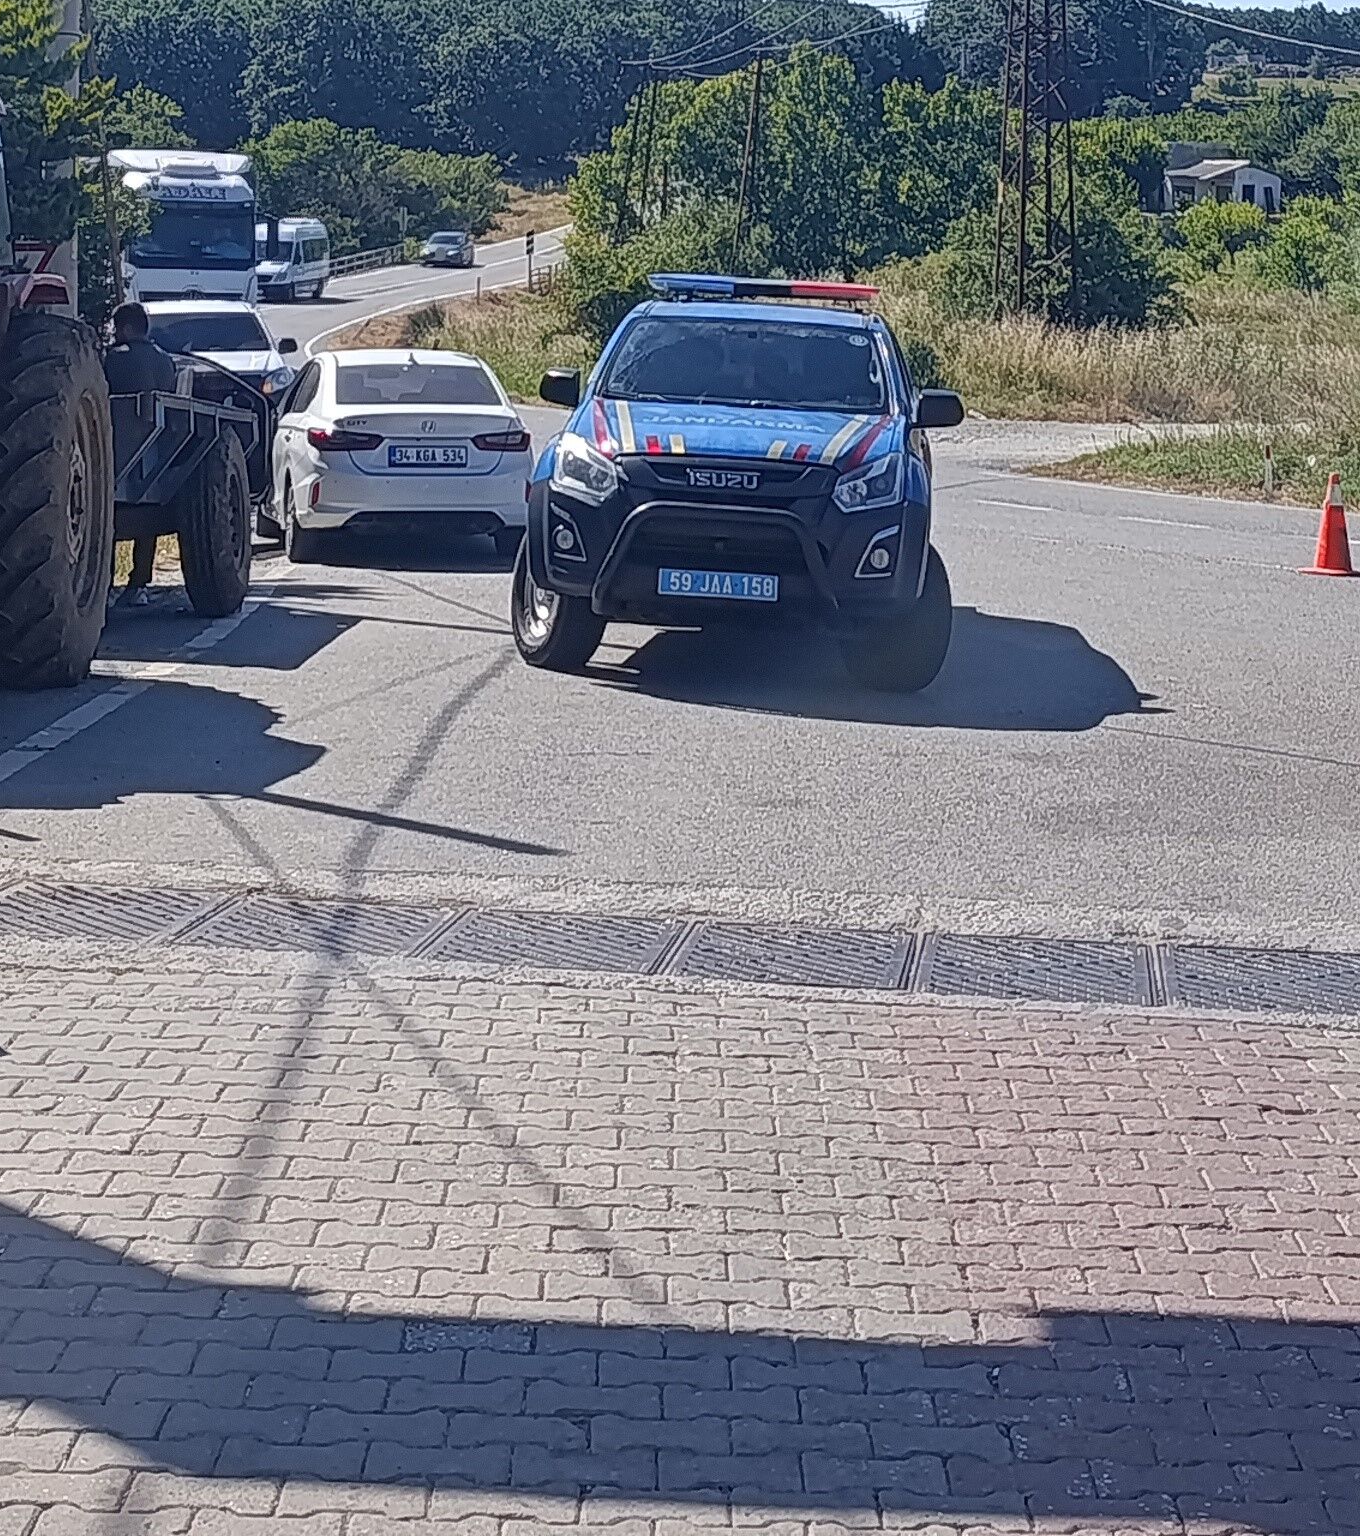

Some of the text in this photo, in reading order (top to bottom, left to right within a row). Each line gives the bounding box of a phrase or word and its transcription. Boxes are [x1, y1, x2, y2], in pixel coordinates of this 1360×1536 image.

[642, 415, 826, 433] JANDARMA
[443, 449, 464, 462] 534
[687, 470, 759, 490] ISUZU
[669, 571, 774, 596] 59 JAA 158
